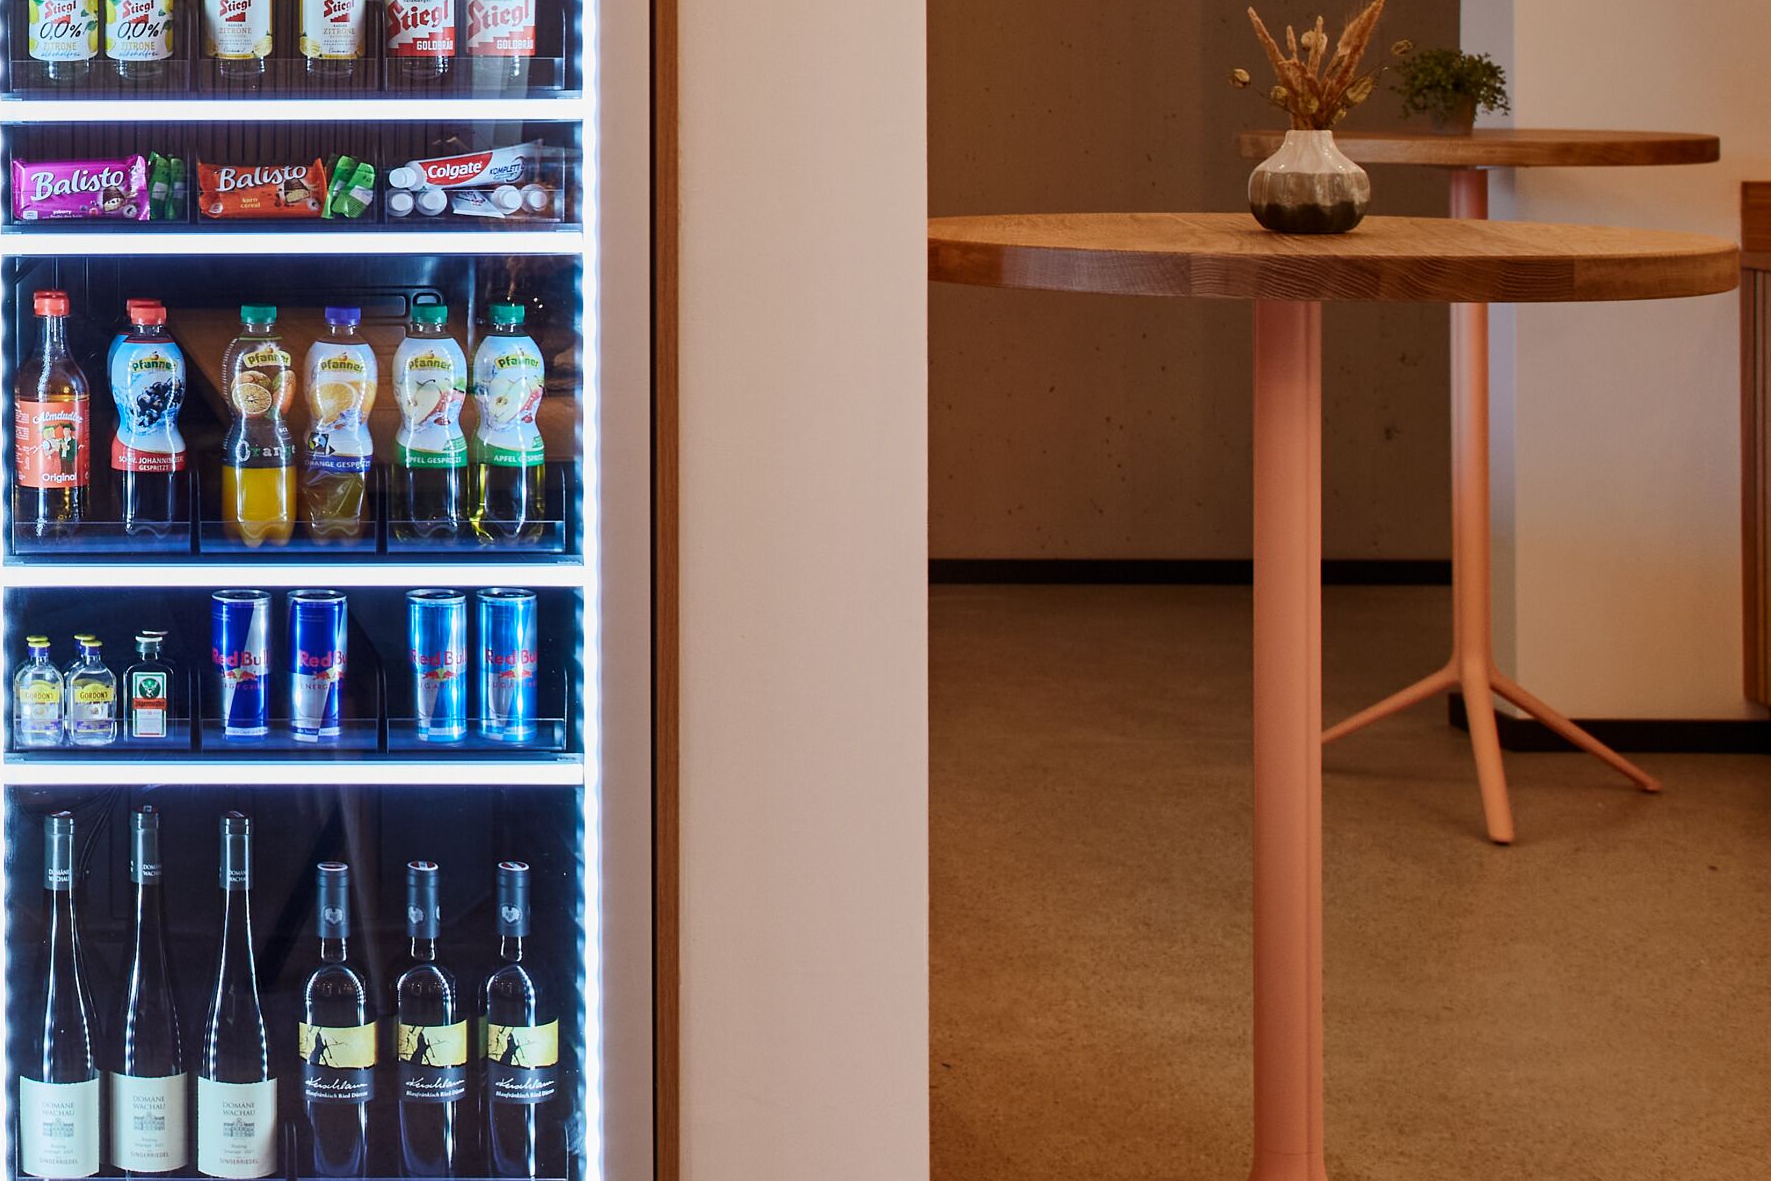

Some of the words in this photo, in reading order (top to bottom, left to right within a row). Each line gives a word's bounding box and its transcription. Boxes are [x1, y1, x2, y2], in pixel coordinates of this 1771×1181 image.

[44, 0, 76, 19] Stiegl
[122, 0, 154, 19] Stiegl
[323, 27, 355, 35] ZITRONE
[43, 42, 77, 51] ZITRONE
[121, 41, 155, 51] ZITRONE
[428, 160, 482, 180] Colgate
[489, 164, 520, 175] KOMPLETT
[30, 167, 124, 202] Balisto
[216, 165, 307, 192] Balisto
[493, 455, 517, 464] APFEL
[42, 472, 77, 483] Original
[212, 648, 238, 667] Red
[241, 648, 269, 666] Bull
[299, 650, 332, 667] Red
[333, 650, 348, 665] Bu
[410, 649, 441, 665] Red
[485, 649, 517, 665] Red
[338, 1090, 351, 1099] Ried
[440, 1089, 452, 1098] Ried
[529, 1089, 541, 1098] Ried
